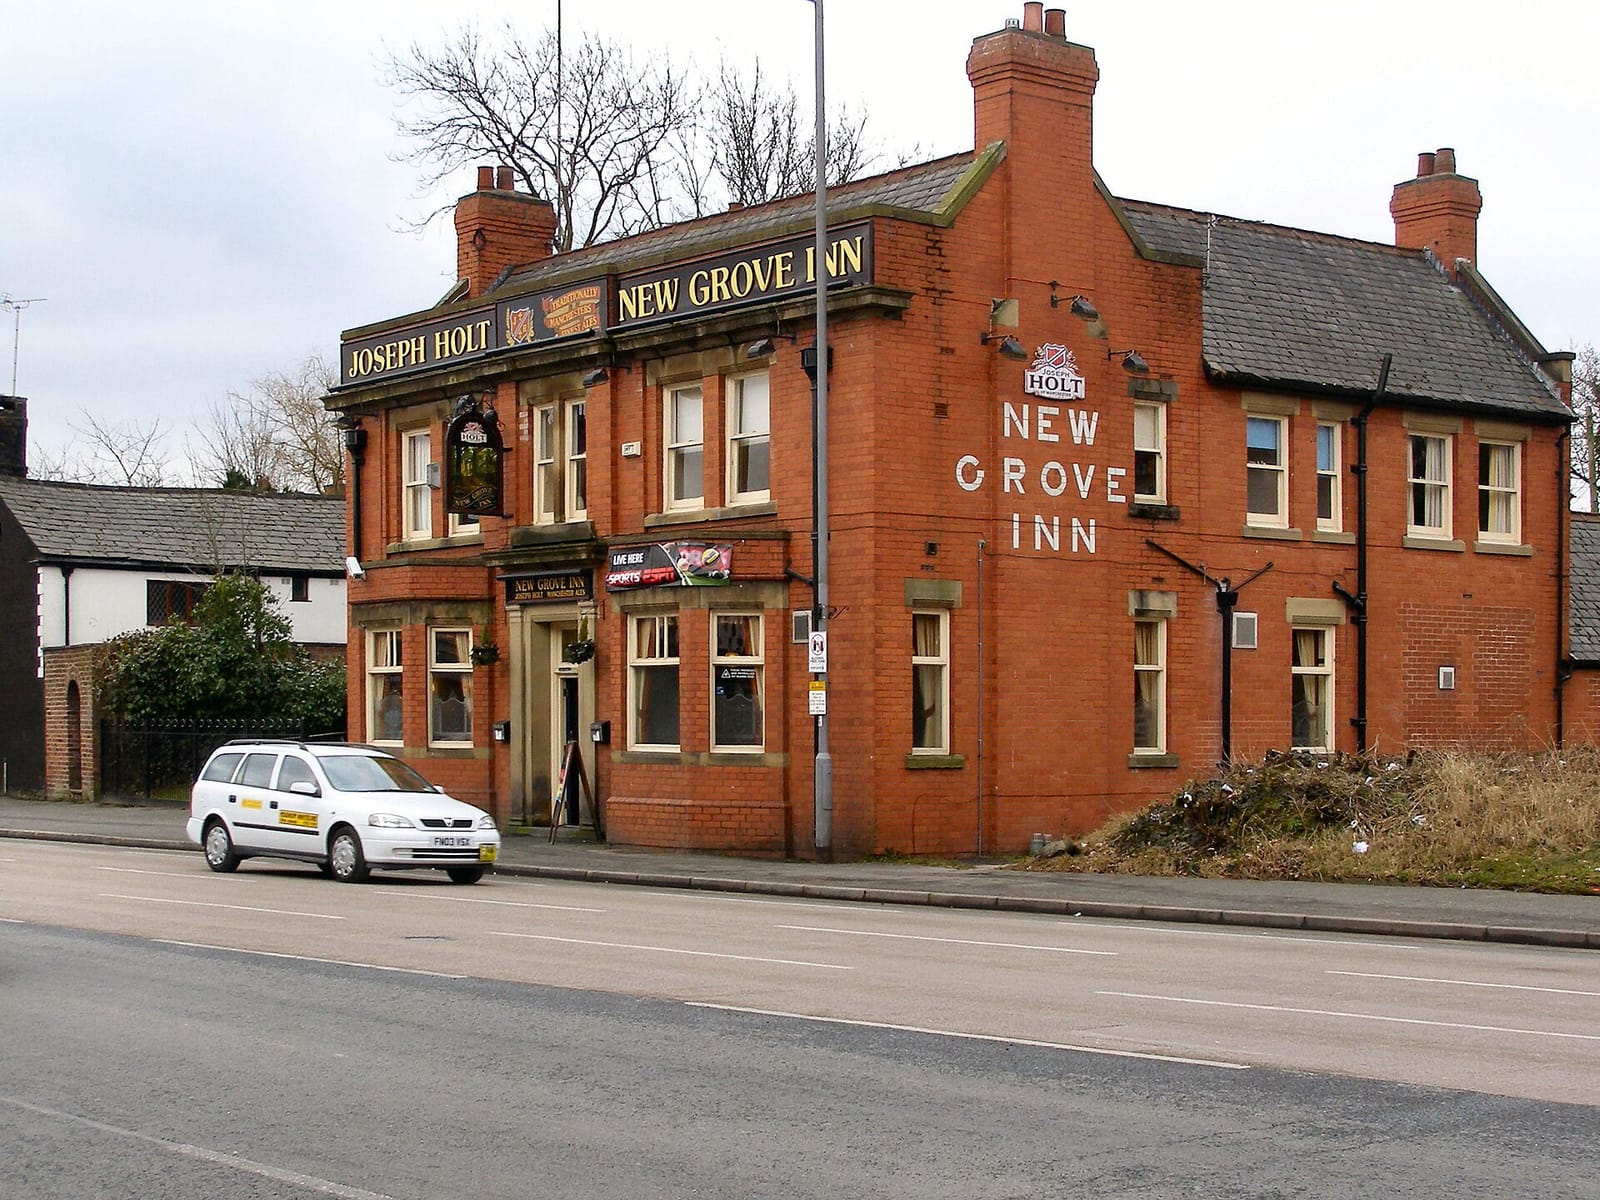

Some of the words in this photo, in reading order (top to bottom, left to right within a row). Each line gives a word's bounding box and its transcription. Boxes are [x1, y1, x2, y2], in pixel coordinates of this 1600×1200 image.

[618, 278, 679, 322] NEW
[688, 252, 796, 306] GROVE
[805, 236, 863, 283] INN
[582, 317, 598, 329] ALES
[348, 335, 426, 378] JOSEPH
[434, 320, 491, 360] HOLT
[1042, 369, 1071, 378] JOSEPH
[1029, 374, 1083, 393] HOLT
[1003, 402, 1099, 446] NEW
[461, 432, 487, 442] HOLT
[955, 454, 1127, 503] GROVE
[1012, 512, 1097, 554] INN
[613, 554, 628, 565] LIVE
[628, 552, 644, 564] HERE
[515, 579, 534, 592] NEW
[537, 577, 566, 590] GROVE
[569, 576, 585, 589] INN
[608, 572, 641, 584] SPORTS
[642, 567, 675, 582] ESPN
